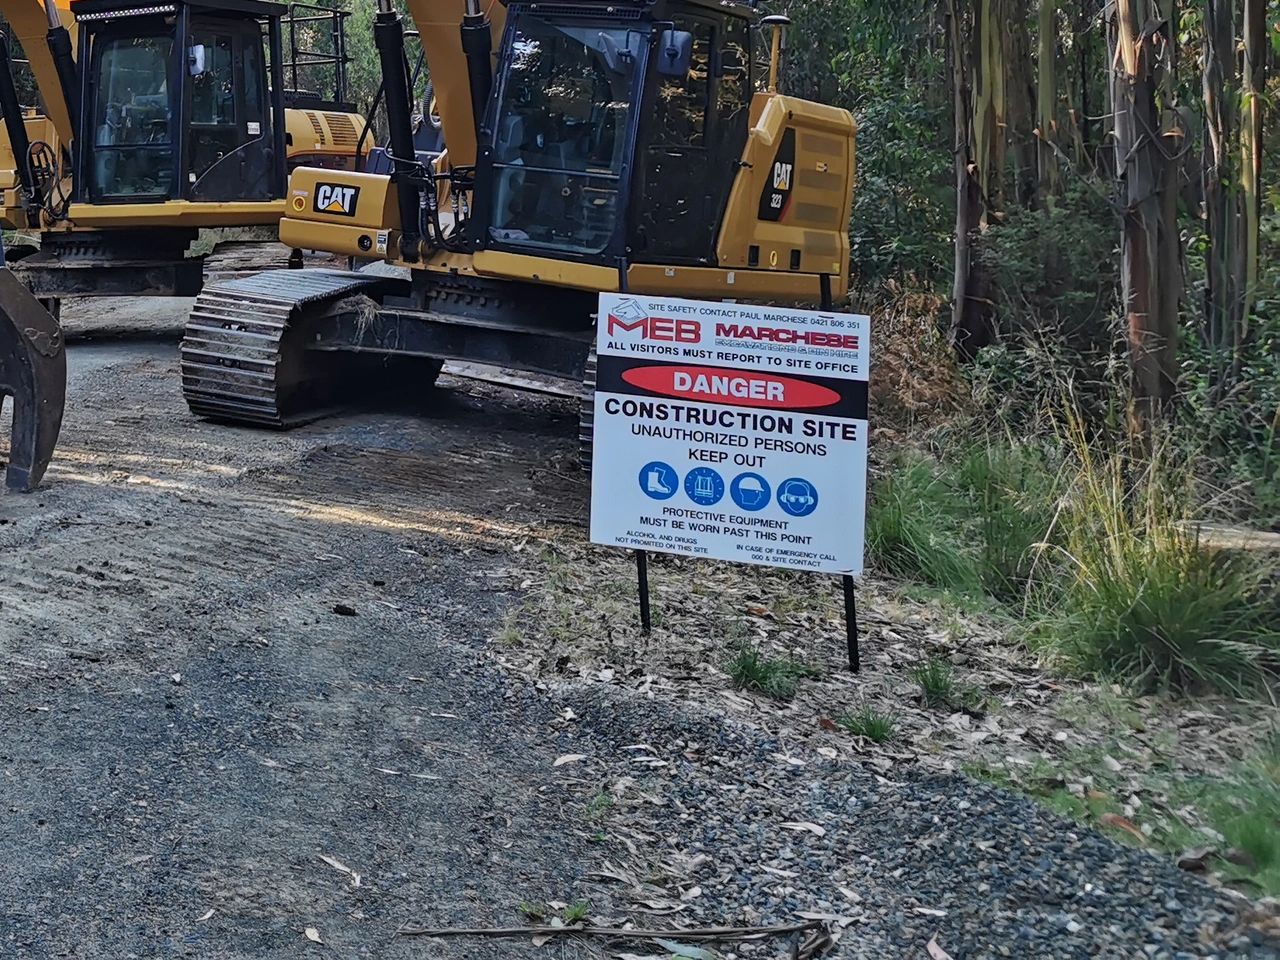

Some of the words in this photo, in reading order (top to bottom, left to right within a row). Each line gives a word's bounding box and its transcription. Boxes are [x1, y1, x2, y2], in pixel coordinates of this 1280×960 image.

[774, 161, 792, 190] CAT
[317, 185, 355, 213] CAT
[770, 193, 783, 208] 323
[608, 313, 702, 344] MEB
[648, 303, 666, 312] SITE
[667, 305, 697, 315] SAFETY
[700, 308, 738, 318] CONTACT
[740, 312, 760, 320] PAUL
[764, 314, 808, 324] MARCHESE
[810, 318, 828, 326] 0421
[847, 321, 860, 329] 351
[715, 322, 859, 349] MARCHESE
[607, 342, 626, 350] ALL
[630, 343, 679, 355] VISITORS
[683, 348, 713, 359] MUST
[717, 352, 762, 363] REPORT
[766, 356, 782, 366] TO
[786, 358, 811, 369] SITE
[815, 361, 859, 373] OFFICE
[674, 371, 785, 402] DANGER
[605, 398, 793, 434] CONSTRUCTION
[802, 419, 857, 441] SITE
[631, 423, 748, 448] UNAUTHORIZED
[754, 437, 827, 456] PERSONS
[688, 448, 728, 463] KEEP
[734, 453, 766, 468] OUT
[640, 516, 668, 527] MUST
[672, 520, 685, 529] BE
[689, 523, 720, 534] WORN
[724, 526, 750, 538] PAST
[754, 530, 777, 541] THIS
[781, 534, 812, 545] POINT
[662, 507, 726, 522] PROTECTIVE
[729, 515, 789, 530] EQUIPMENT
[626, 530, 657, 540] ALCOHOL
[674, 536, 698, 544] DRUGS
[677, 544, 692, 552] THIS
[693, 546, 708, 554] SITE
[745, 545, 763, 553] CASE
[776, 549, 818, 559] EMERGENCY
[819, 553, 838, 561] CALL
[751, 553, 764, 561] 000
[789, 558, 822, 567] CONTACT
